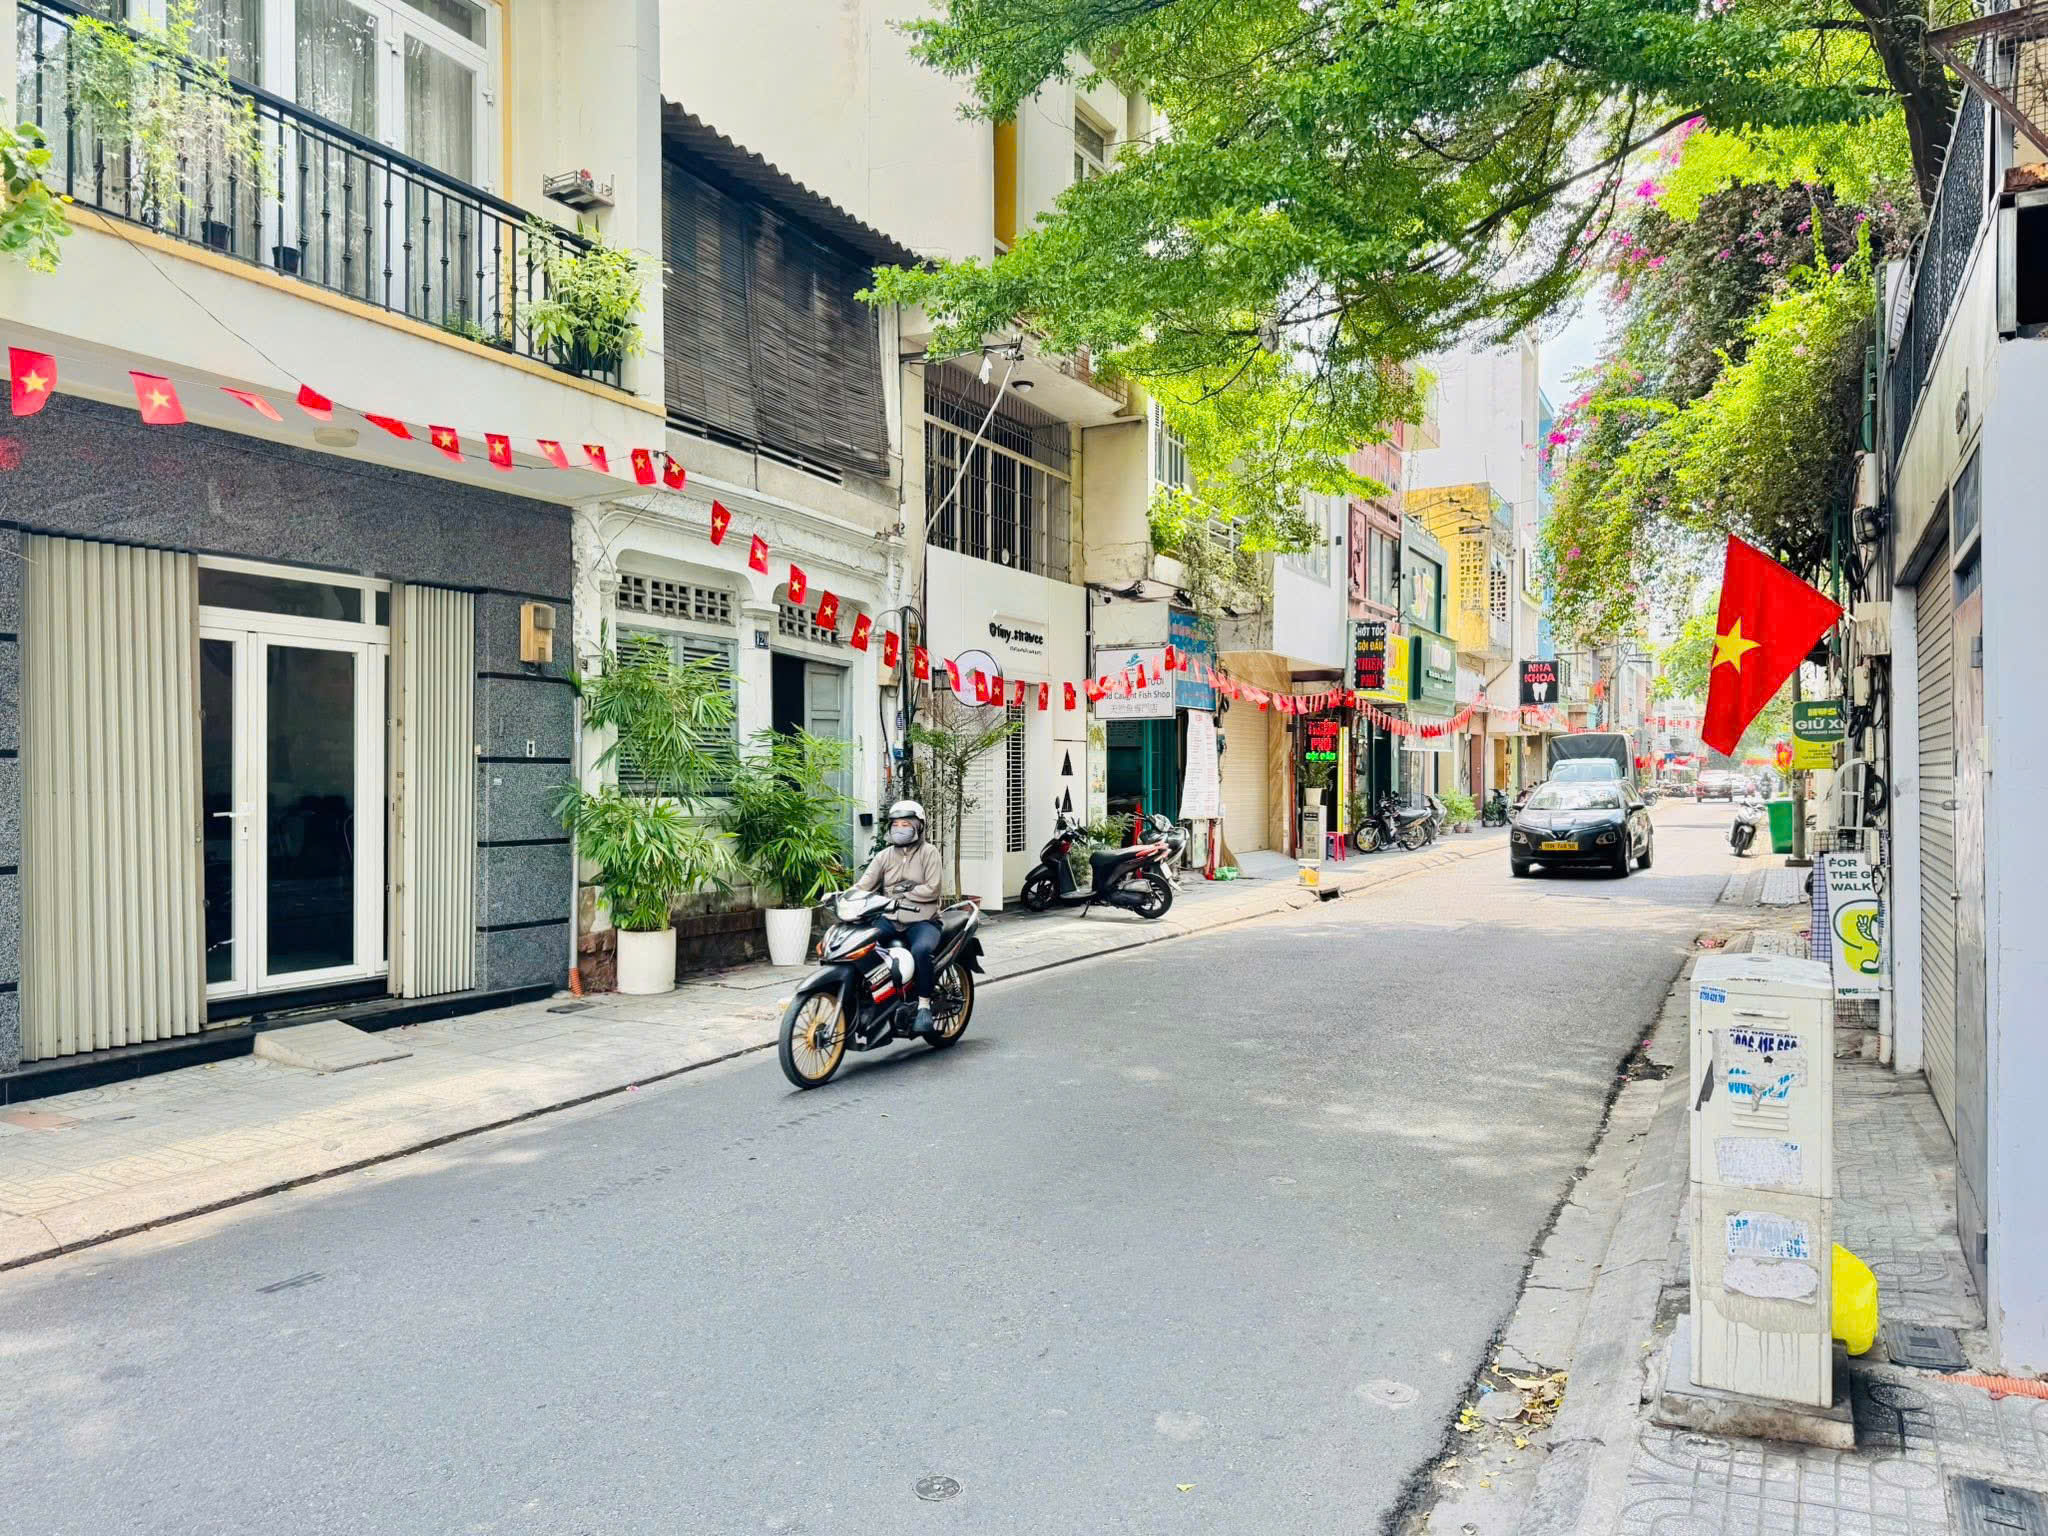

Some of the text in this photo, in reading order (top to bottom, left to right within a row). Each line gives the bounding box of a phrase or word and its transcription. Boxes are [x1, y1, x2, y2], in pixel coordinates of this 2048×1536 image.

[1528, 664, 1552, 672] NHA
[1524, 673, 1556, 682] KHOA
[1795, 717, 1825, 730] GIỮ
[1829, 859, 1858, 867] FOR
[1830, 871, 1858, 879] THE
[1831, 882, 1873, 891] WALK
